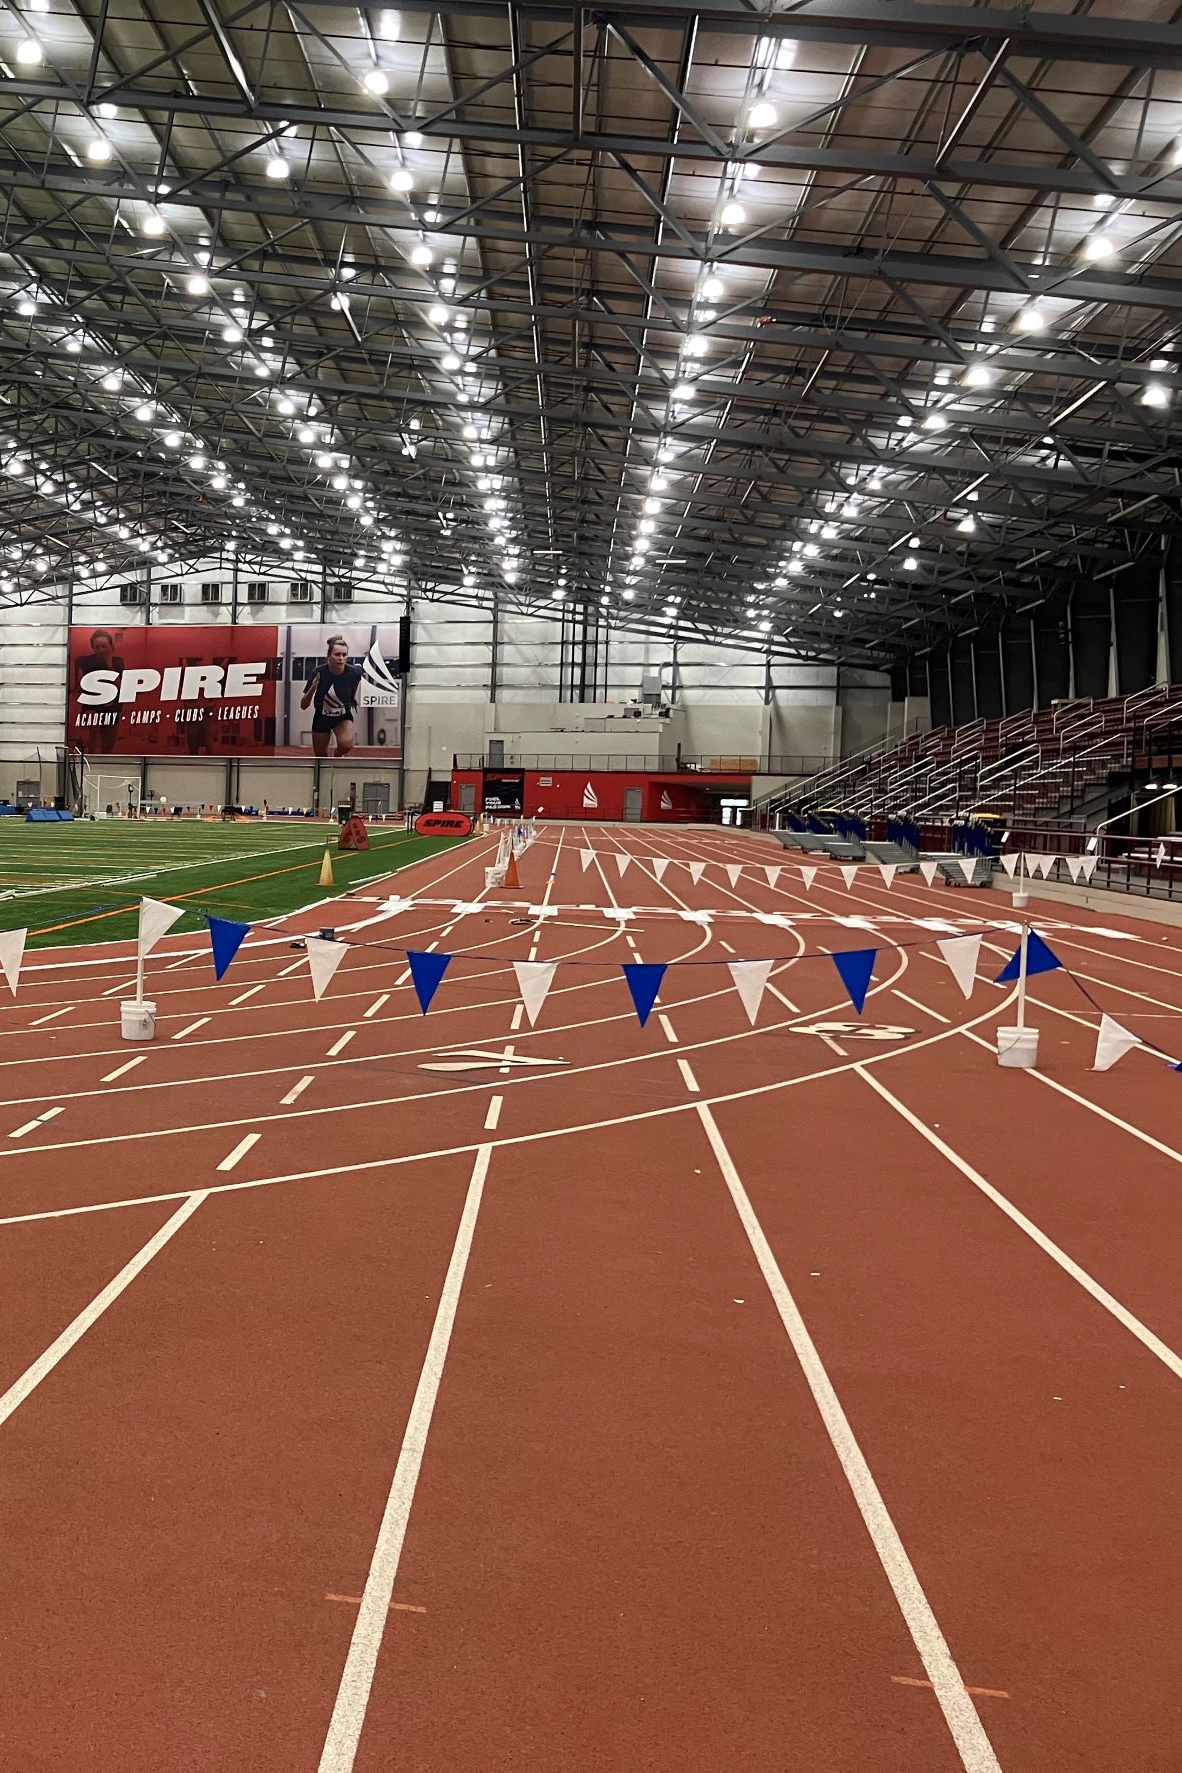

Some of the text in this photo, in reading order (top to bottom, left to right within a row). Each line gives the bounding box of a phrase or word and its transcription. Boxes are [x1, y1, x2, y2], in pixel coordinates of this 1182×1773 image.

[76, 662, 267, 706] SPIRE
[363, 695, 396, 705] SPIRE
[75, 705, 260, 727] ACADEMY CAMPS CLUBS LEAGUES
[423, 819, 465, 828] SPIRE
